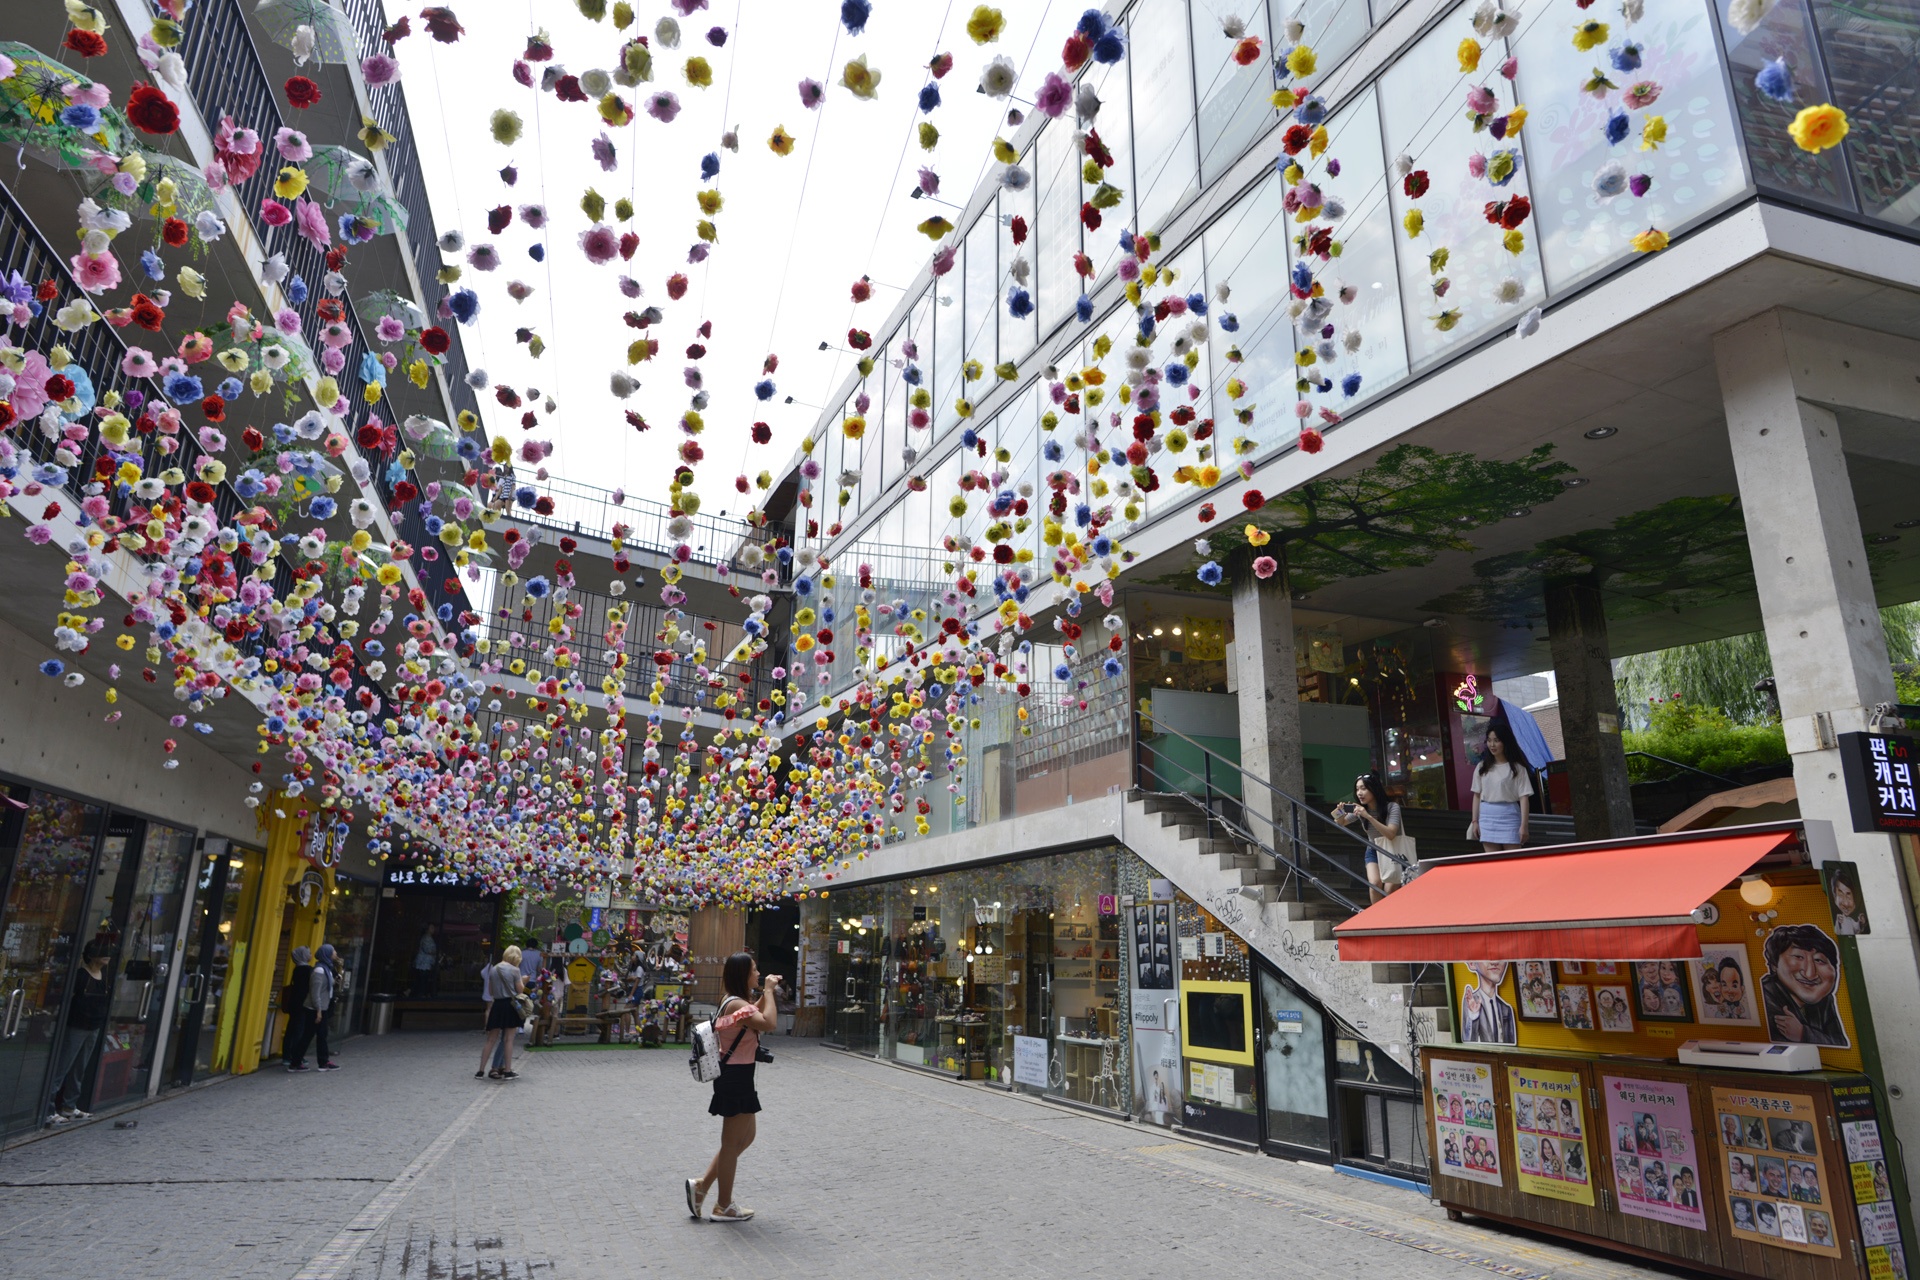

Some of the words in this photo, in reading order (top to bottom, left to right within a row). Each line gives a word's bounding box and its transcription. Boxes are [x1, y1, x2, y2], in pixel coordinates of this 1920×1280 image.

[1869, 738, 1888, 760] 편
[1873, 761, 1912, 786] 캐리
[390, 870, 415, 884] 타로
[420, 872, 429, 885] &
[433, 872, 460, 886] 사주
[1134, 1012, 1158, 1024] #flippoly
[1445, 1072, 1457, 1080] 일반
[1520, 1077, 1539, 1089] PET
[1619, 1090, 1636, 1103] 웨딩
[1729, 1095, 1748, 1106] VIP
[1749, 1097, 1793, 1112] 작품주문
